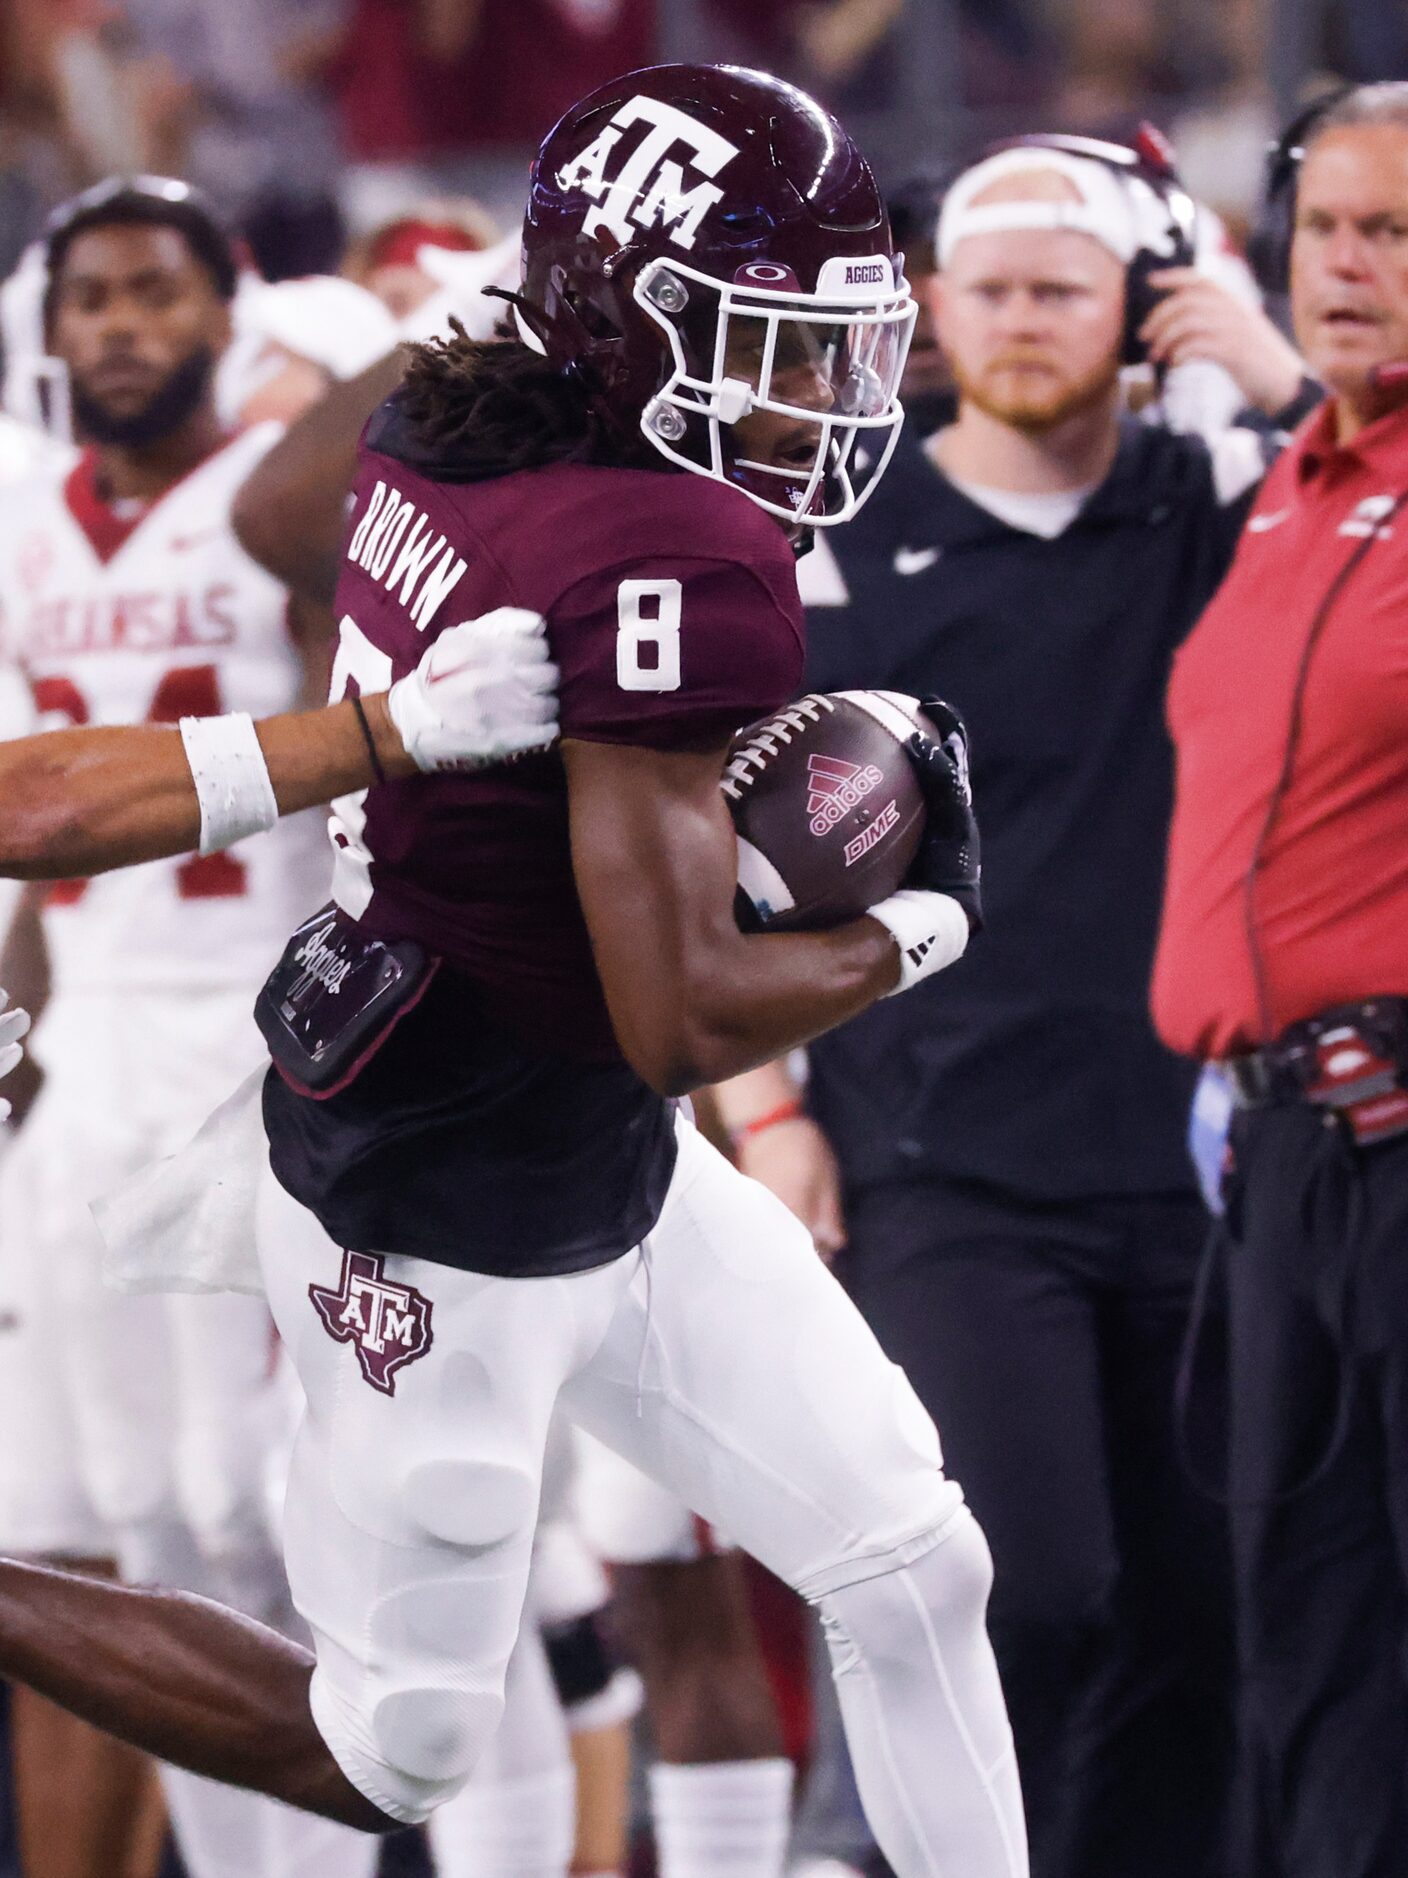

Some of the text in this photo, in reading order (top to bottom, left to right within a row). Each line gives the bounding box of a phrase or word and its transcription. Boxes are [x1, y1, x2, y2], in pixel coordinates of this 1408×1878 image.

[845, 264, 884, 285] AGGIES
[347, 479, 468, 632] BROWN
[616, 579, 683, 692] 8
[809, 764, 885, 837] adidas
[843, 799, 901, 868] DIME
